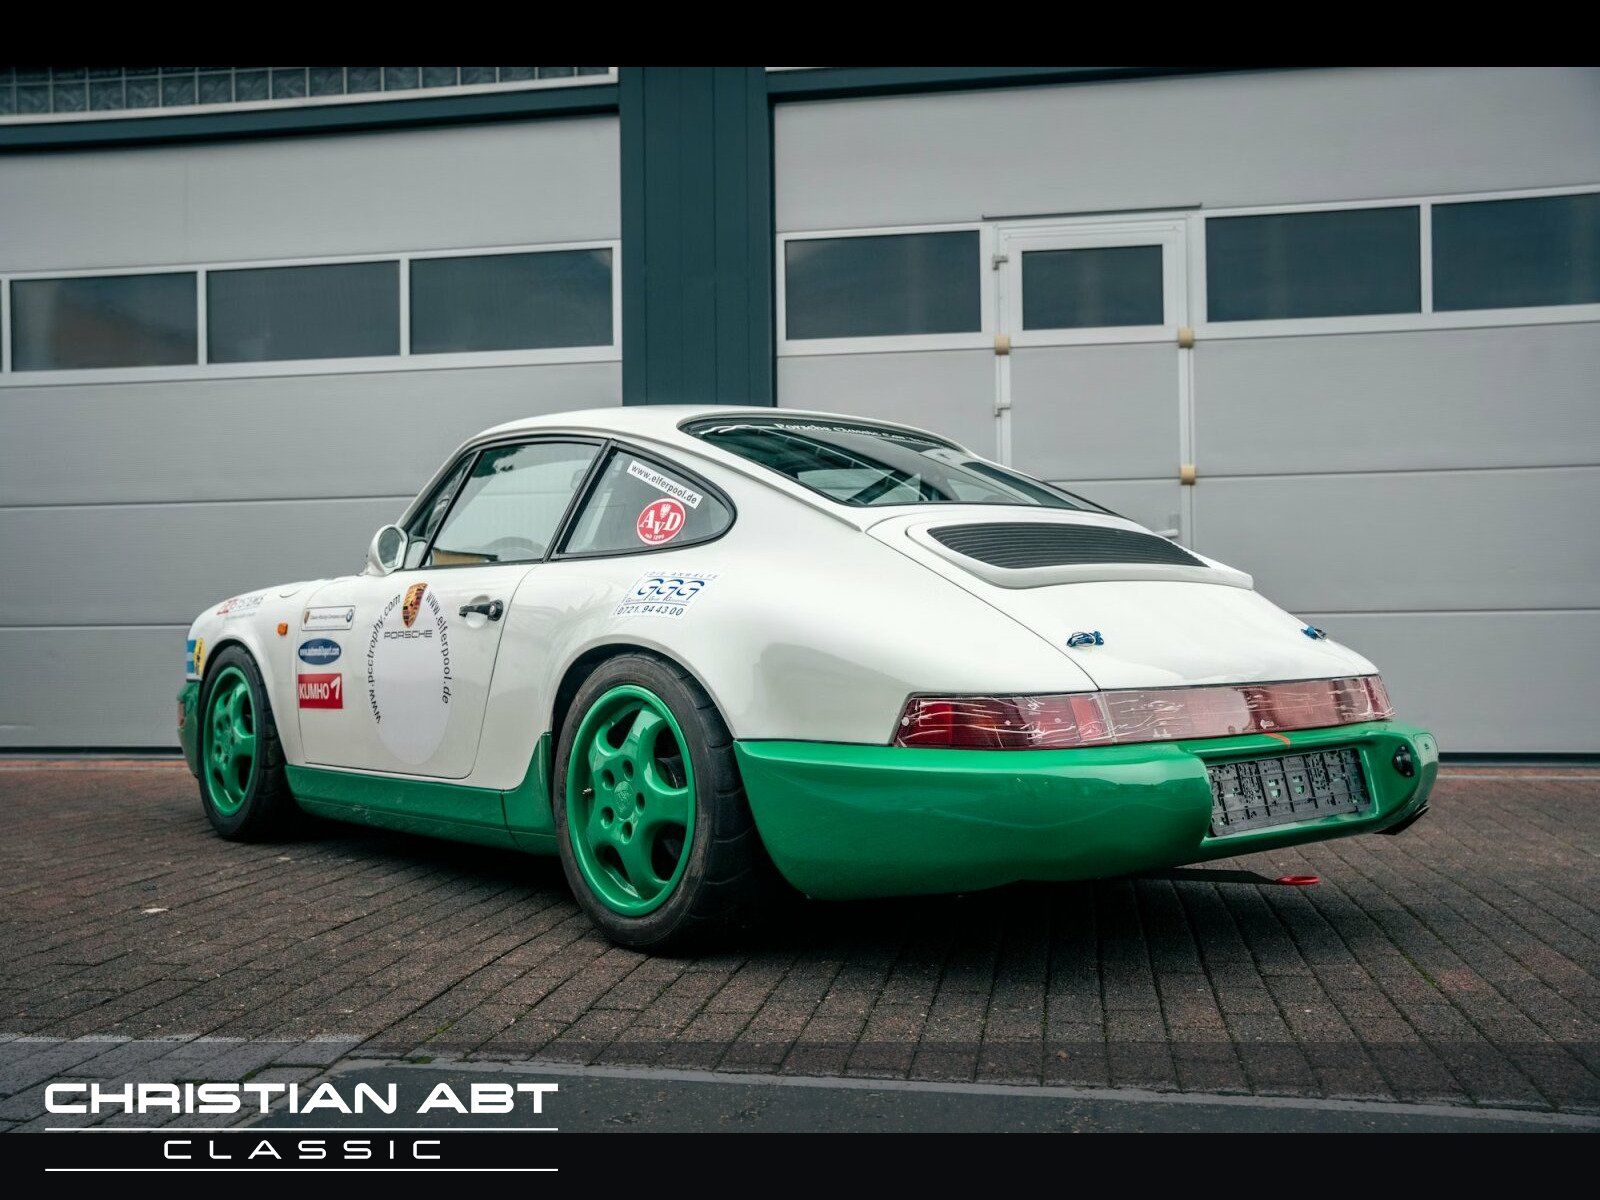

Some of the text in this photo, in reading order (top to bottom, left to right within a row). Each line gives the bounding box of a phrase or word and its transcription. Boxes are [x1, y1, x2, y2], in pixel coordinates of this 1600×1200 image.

[631, 464, 697, 504] www.elferpool.de
[384, 629, 433, 639] PORSCHE
[426, 591, 452, 705] www.elferpool.de
[366, 594, 401, 724] www.pcctrophy.com
[299, 683, 330, 700] KUMHO
